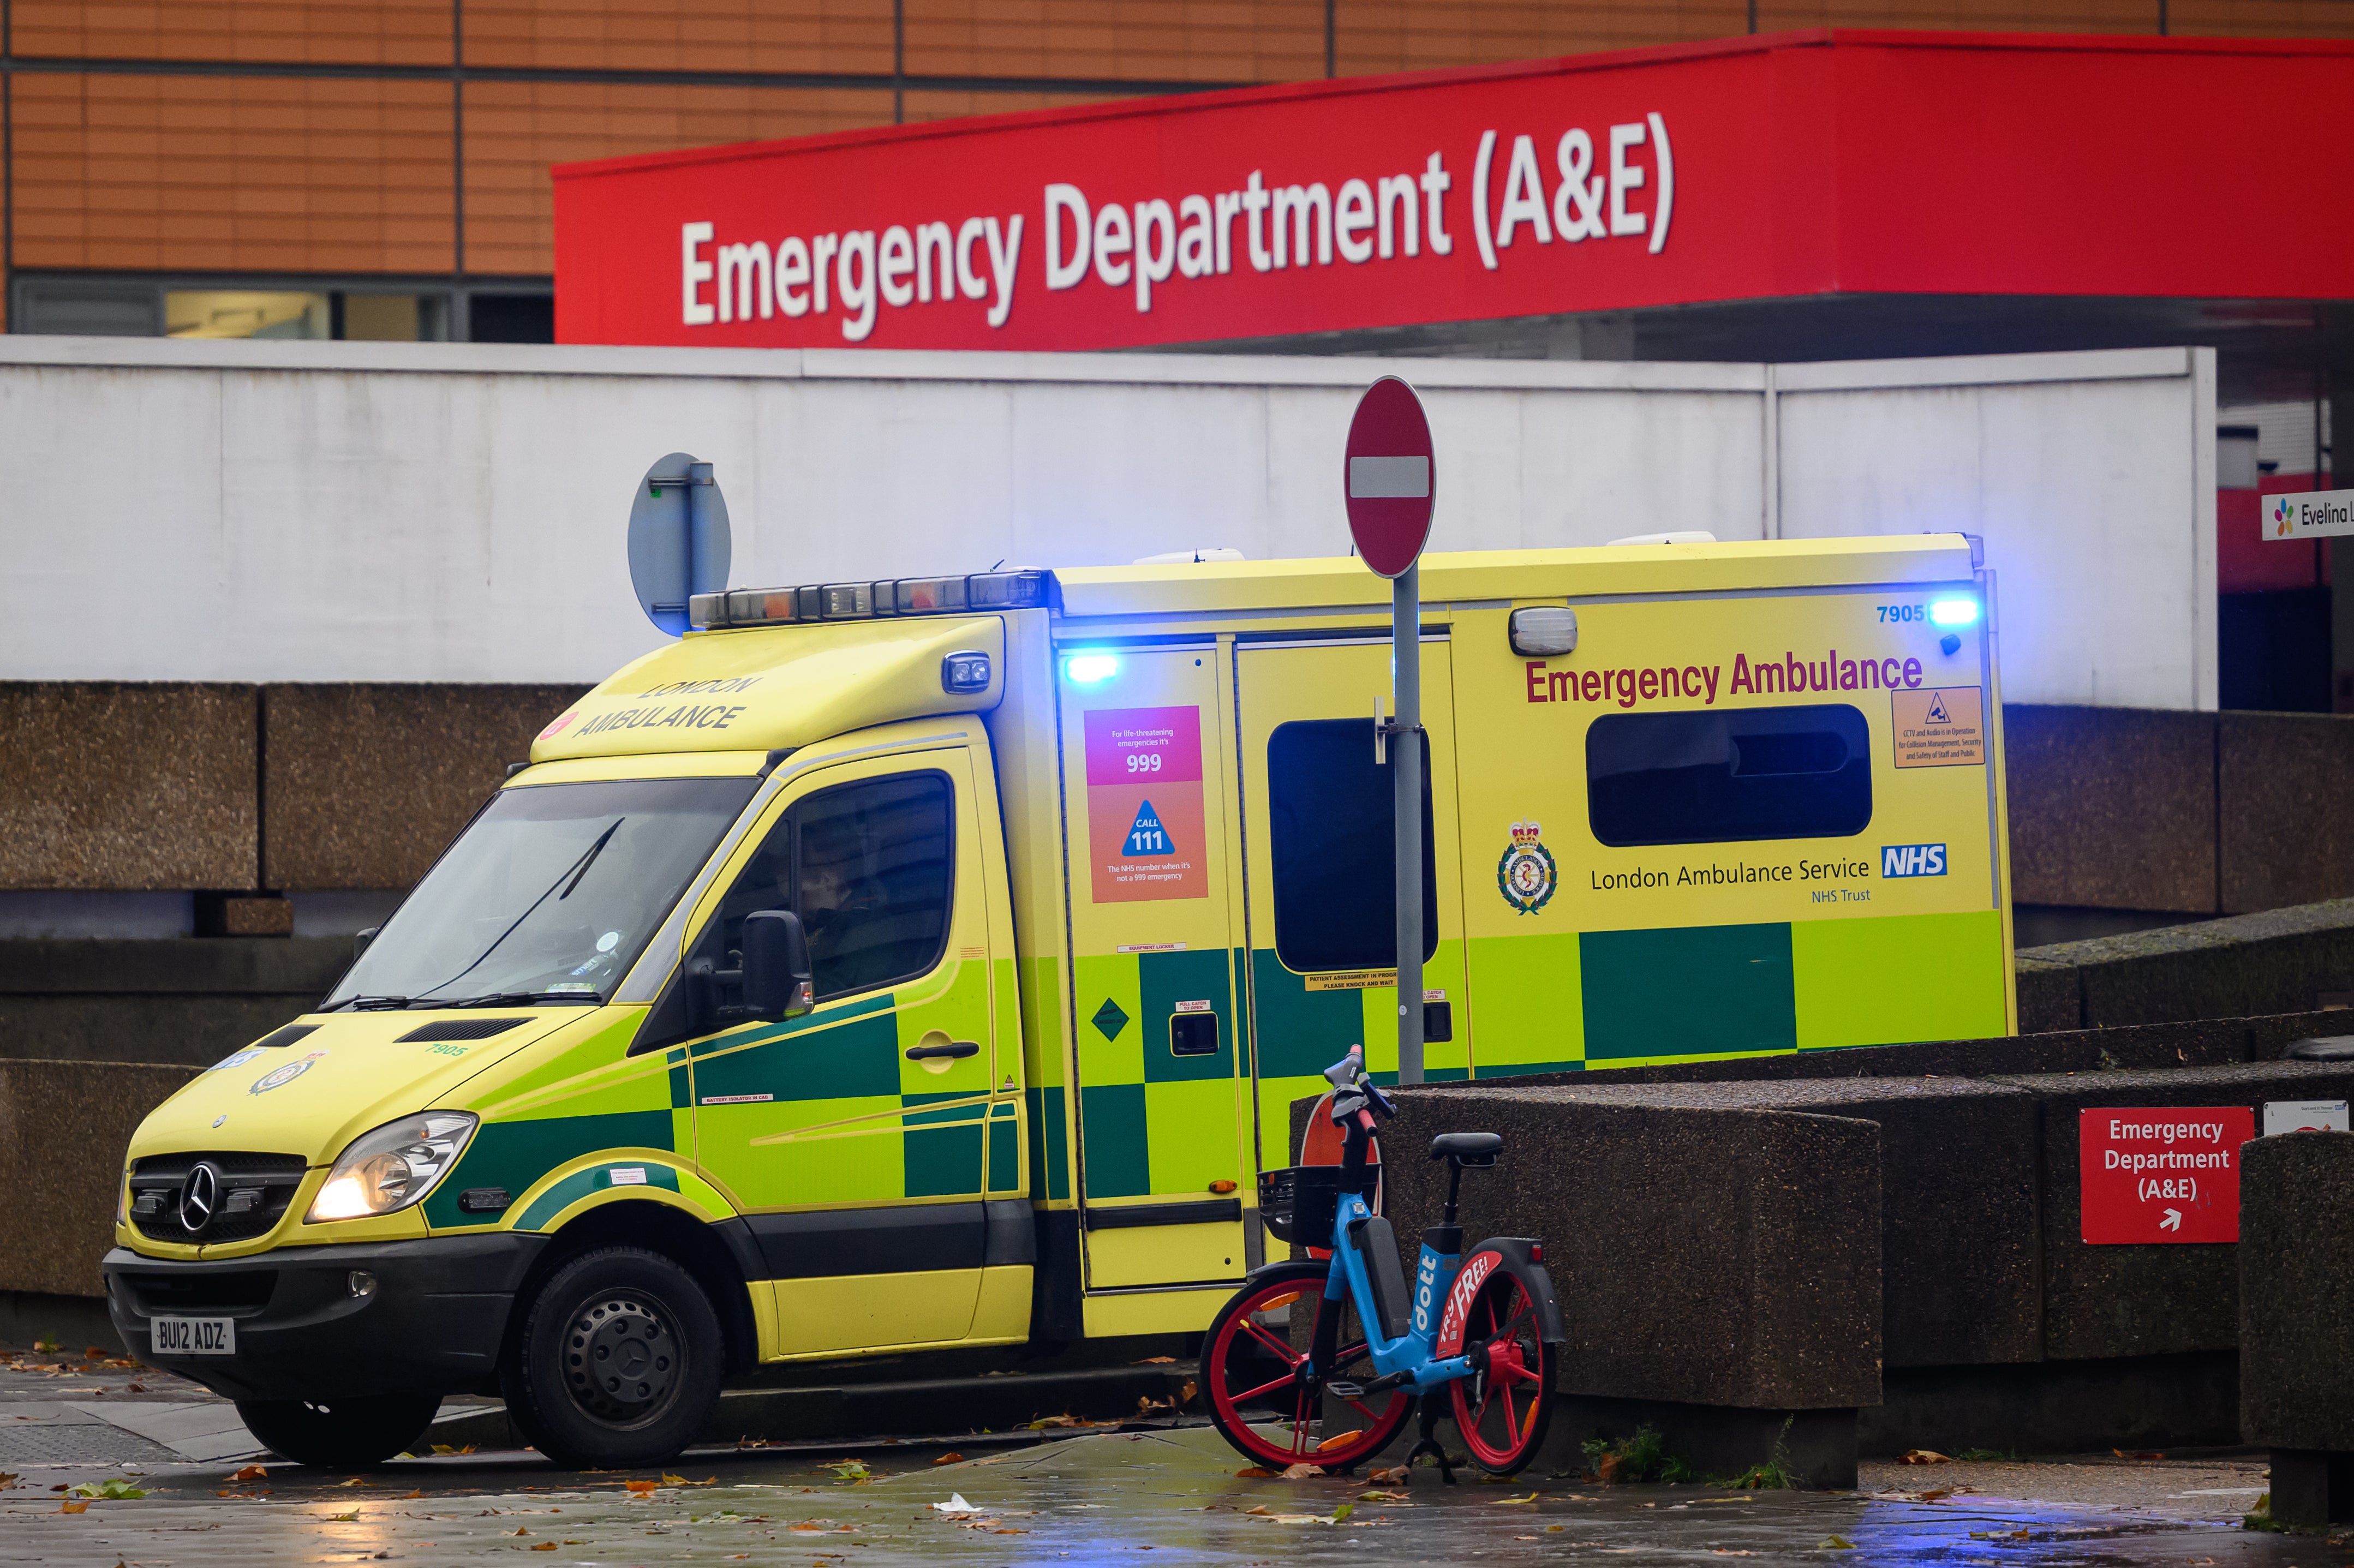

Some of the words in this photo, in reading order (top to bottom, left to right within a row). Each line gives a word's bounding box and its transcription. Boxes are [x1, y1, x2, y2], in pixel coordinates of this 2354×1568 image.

[682, 214, 1024, 341] Emergency
[1043, 151, 1453, 313] Department
[1471, 112, 1674, 270] (A&E)
[2302, 502, 2347, 525] Evelina
[2350, 501, 2354, 522] L
[1877, 605, 1925, 623] 7905
[636, 677, 763, 699] LONDON
[1526, 659, 1720, 709] Emergency
[1730, 649, 1923, 695] Ambulance
[571, 705, 747, 738] AMBULANCE
[1952, 728, 1975, 736] Operation
[1124, 728, 1173, 737] life-threatening
[1962, 739, 1981, 747] Security
[1118, 739, 1158, 748] emergencies
[1127, 753, 1162, 773] 999
[1916, 751, 1931, 760] Safety
[1136, 819, 1158, 828] CALL
[1132, 831, 1162, 850] 111
[1883, 846, 1946, 876] NHS
[1148, 873, 1182, 881] emergency
[1592, 867, 1669, 890] London
[1676, 861, 1792, 886] Ambulance
[1800, 858, 1869, 880] Service
[1812, 890, 1837, 903] NHS
[1841, 889, 1871, 902] Trust
[572, 959, 597, 975] smart
[425, 1044, 469, 1057] 7905
[2110, 1120, 2224, 1144] Emergency
[2105, 1148, 2230, 1174] Department
[2138, 1177, 2197, 1202] (A&E)
[1415, 1255, 1436, 1331] dott
[1454, 1256, 1488, 1321] FREE!
[159, 1321, 189, 1349] BU12
[195, 1322, 224, 1349] ADZ
